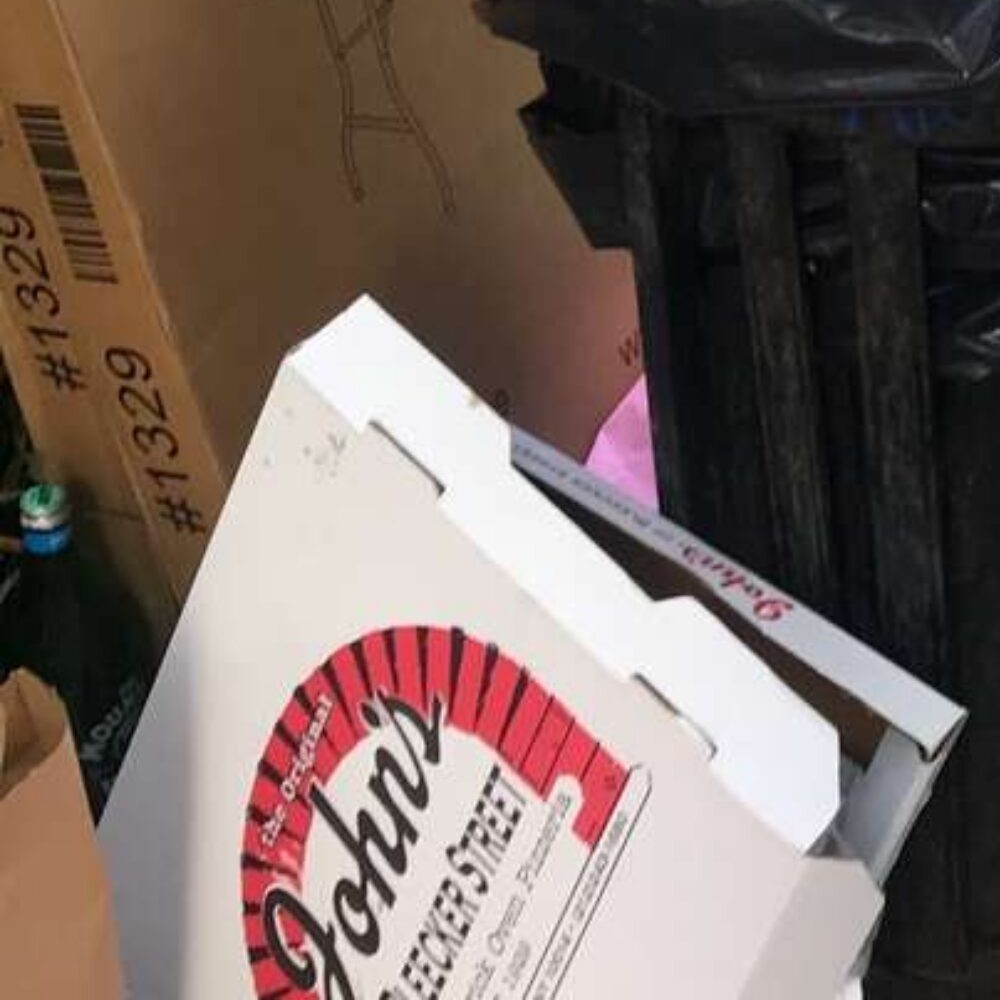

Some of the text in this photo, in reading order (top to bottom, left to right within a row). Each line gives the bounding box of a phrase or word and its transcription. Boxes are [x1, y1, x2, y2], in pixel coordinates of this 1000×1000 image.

[0, 206, 88, 391] #1329
[105, 346, 206, 536] #1329
[264, 690, 442, 1000] John's
[444, 763, 526, 895] STREET
